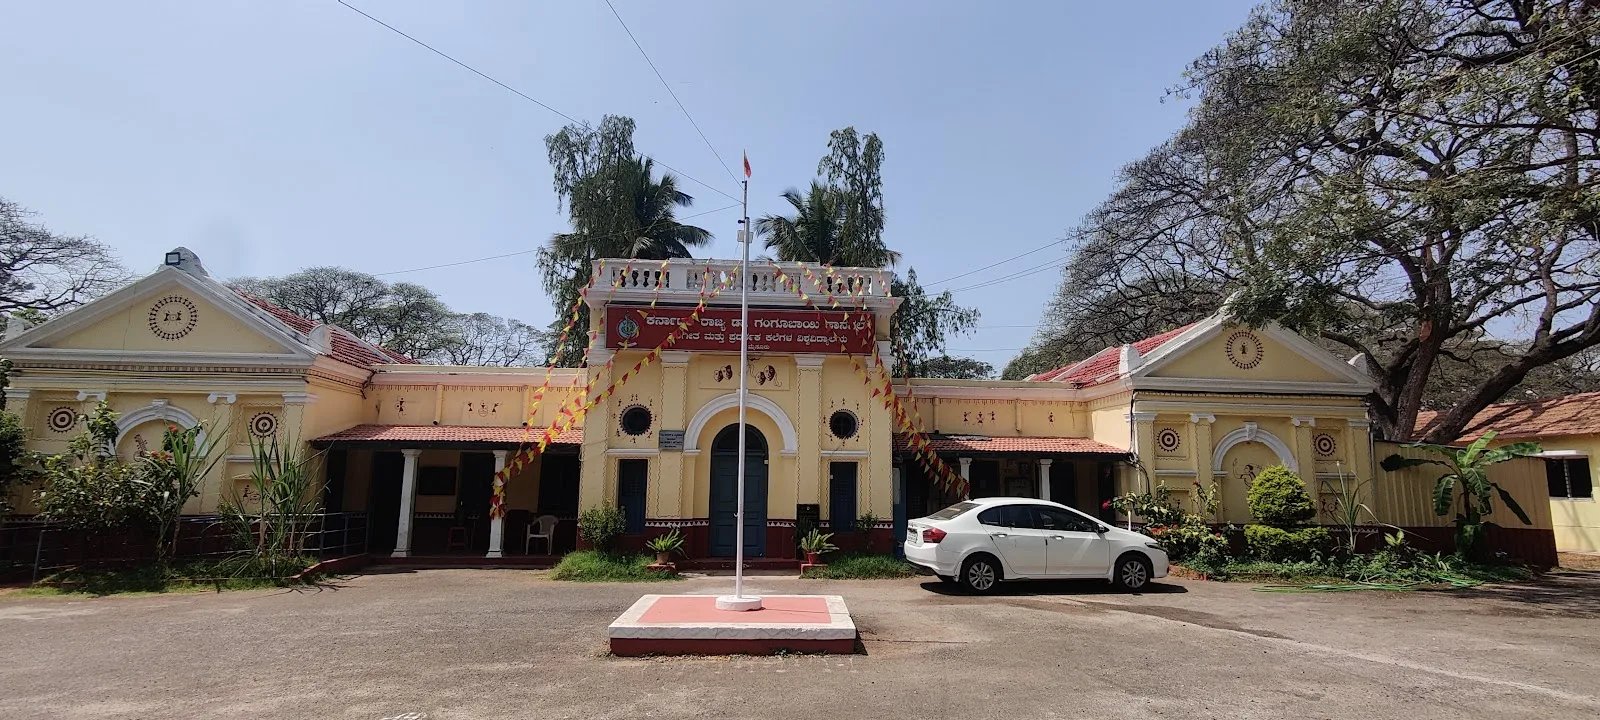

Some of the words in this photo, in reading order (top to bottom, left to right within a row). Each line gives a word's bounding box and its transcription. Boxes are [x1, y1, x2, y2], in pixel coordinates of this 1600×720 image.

[646, 314, 693, 326] ಕರ್ನಾ
[700, 318, 726, 332] ರಾಜ್ಯ
[731, 318, 749, 328] ಡ.
[754, 317, 820, 329] ಗಂಗೂಬಾಯಿ
[703, 332, 725, 344] ಮತ್ತು
[728, 333, 762, 344] ಪ್ರದರ್ಕ
[765, 333, 793, 342] ಕಲೆಗಳ
